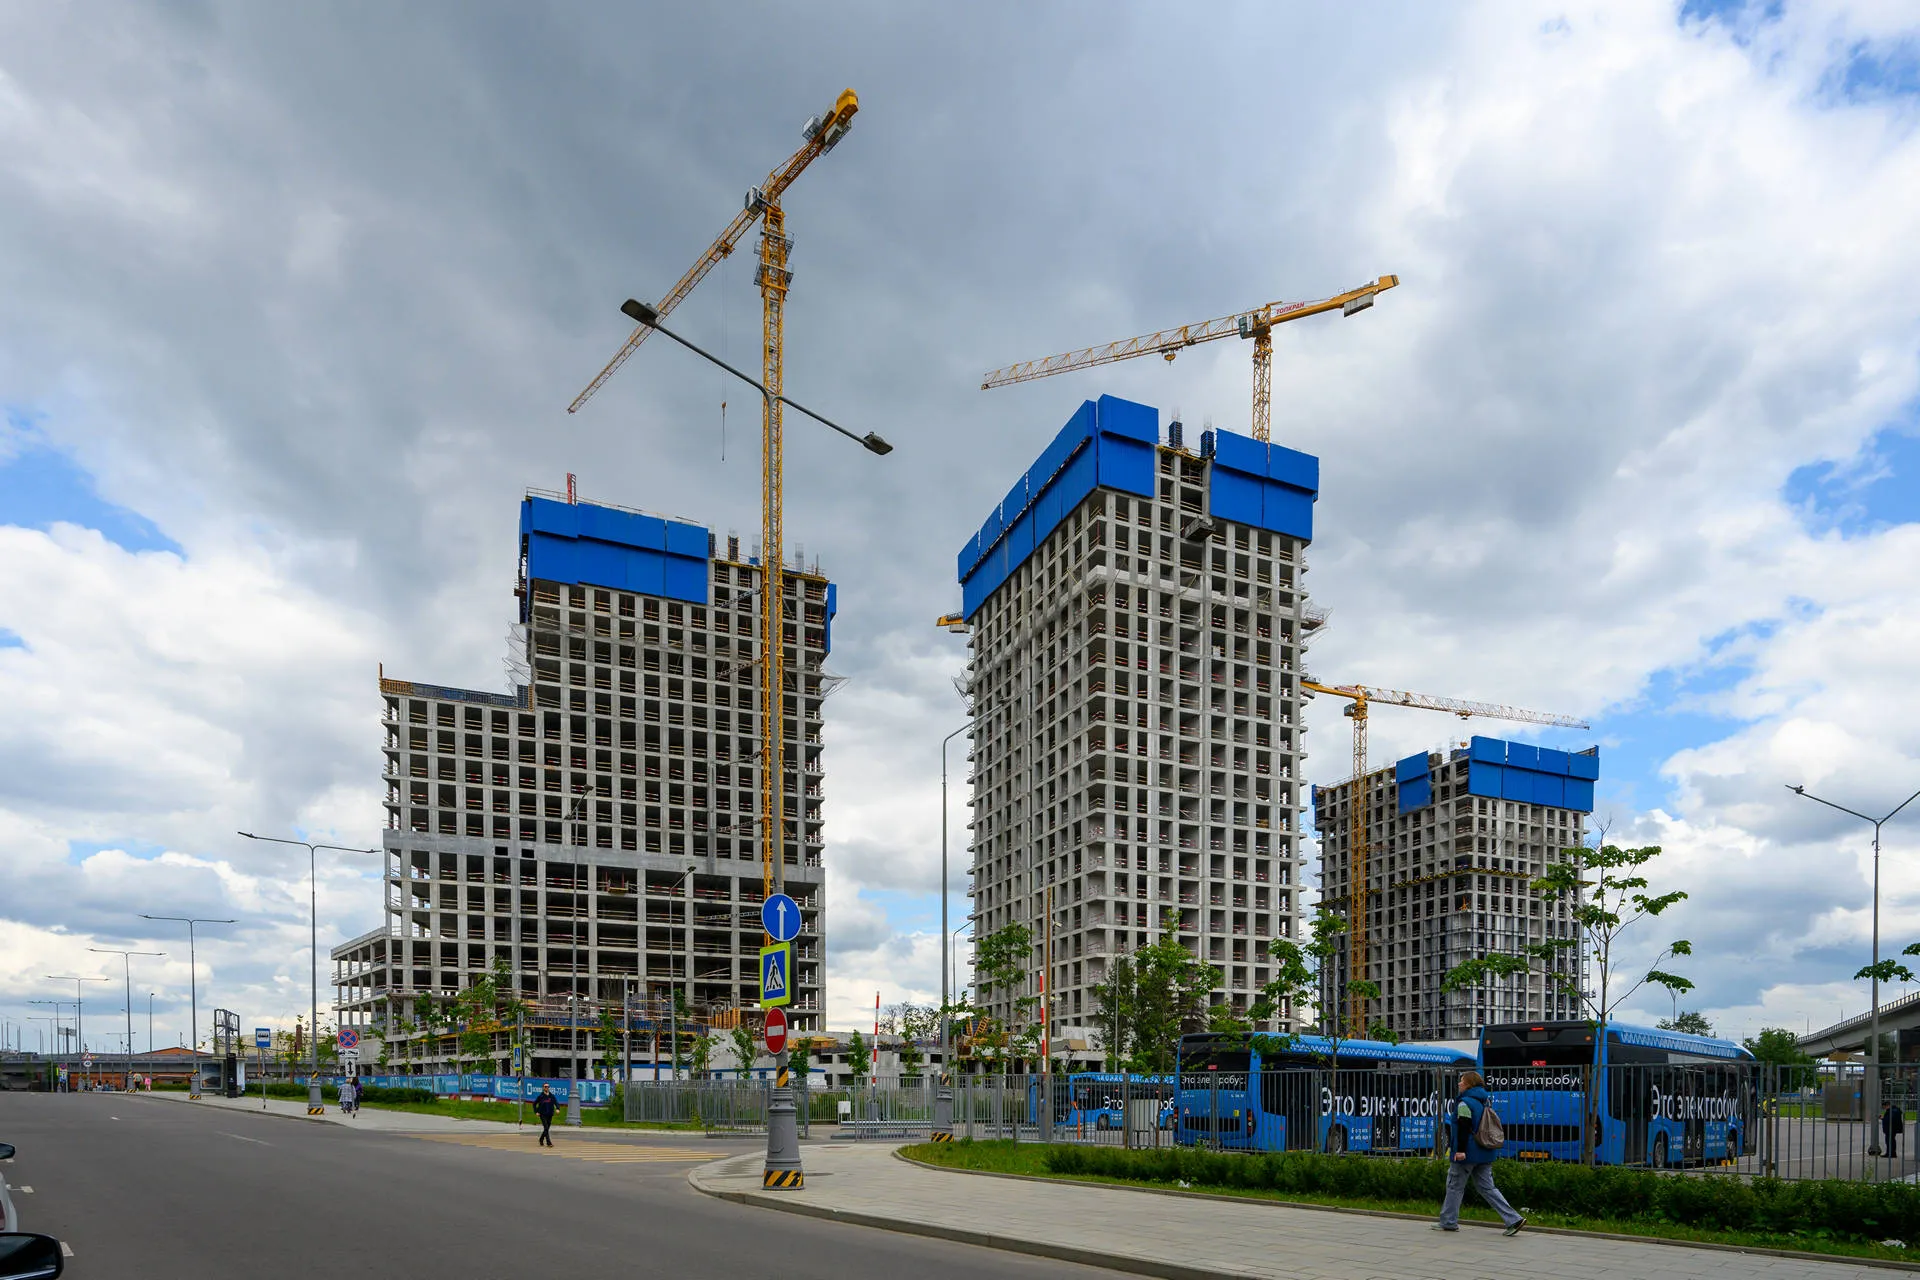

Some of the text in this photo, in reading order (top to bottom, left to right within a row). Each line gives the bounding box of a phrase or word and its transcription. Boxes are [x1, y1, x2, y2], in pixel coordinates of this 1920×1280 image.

[1486, 1075, 1508, 1086] Это
[1103, 1096, 1123, 1110] Это
[1321, 1086, 1355, 1117] Это
[1652, 1085, 1673, 1120] Это
